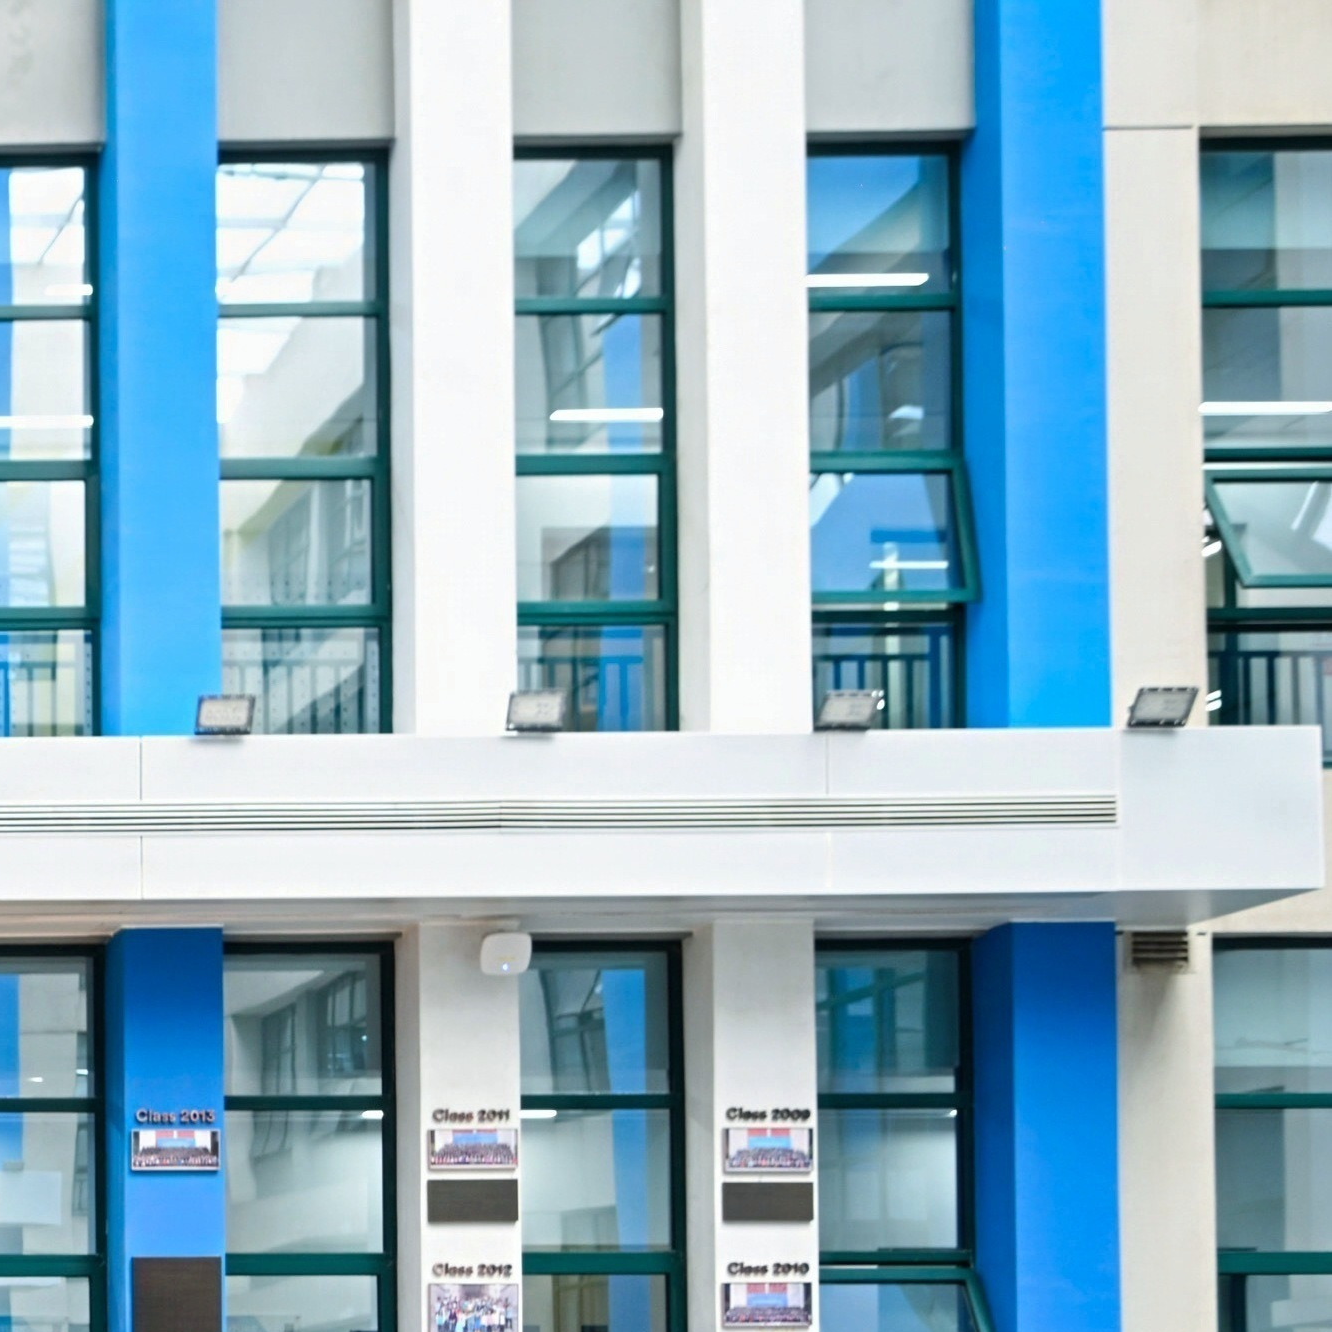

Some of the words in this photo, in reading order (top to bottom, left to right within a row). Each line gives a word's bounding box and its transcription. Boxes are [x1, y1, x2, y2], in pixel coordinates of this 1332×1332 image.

[136, 1109, 176, 1123] Class
[180, 1109, 215, 1123] 2013
[433, 1109, 473, 1123] Class
[726, 1107, 767, 1121] Class
[772, 1108, 810, 1121] 2009
[433, 1264, 473, 1277] Class
[478, 1264, 512, 1277] 2012
[727, 1262, 768, 1276] Class
